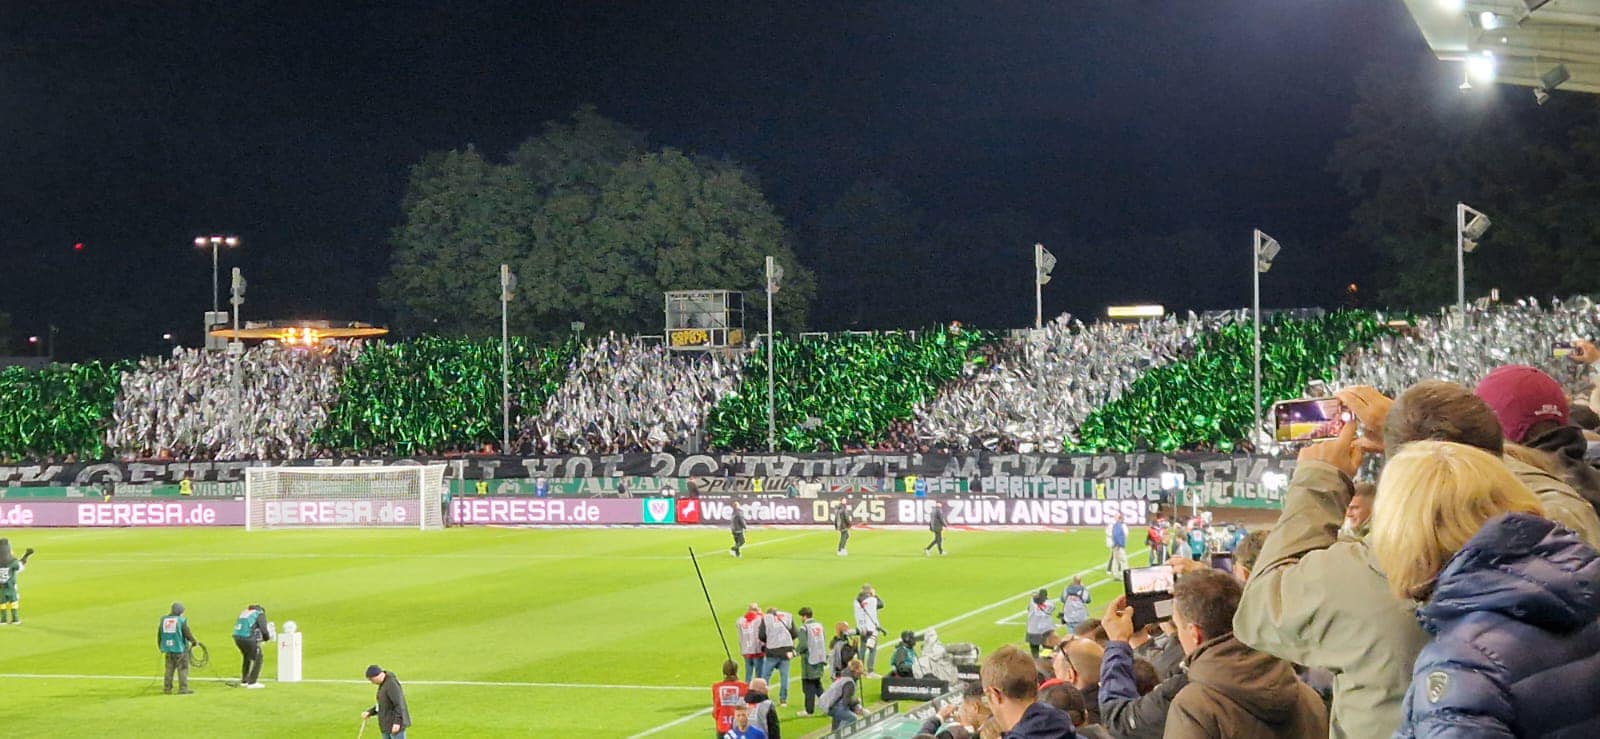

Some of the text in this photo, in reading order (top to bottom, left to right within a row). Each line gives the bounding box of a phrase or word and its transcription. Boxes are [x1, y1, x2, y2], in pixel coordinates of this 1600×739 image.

[78, 503, 216, 525] BERESA.de
[265, 501, 407, 524] BERESA.de
[453, 500, 600, 522] BERESA.de
[701, 501, 800, 521] Wetfalen
[898, 500, 937, 523] BIS
[947, 500, 1005, 523] ZUM
[1011, 500, 1146, 523] ANSTOSS!
